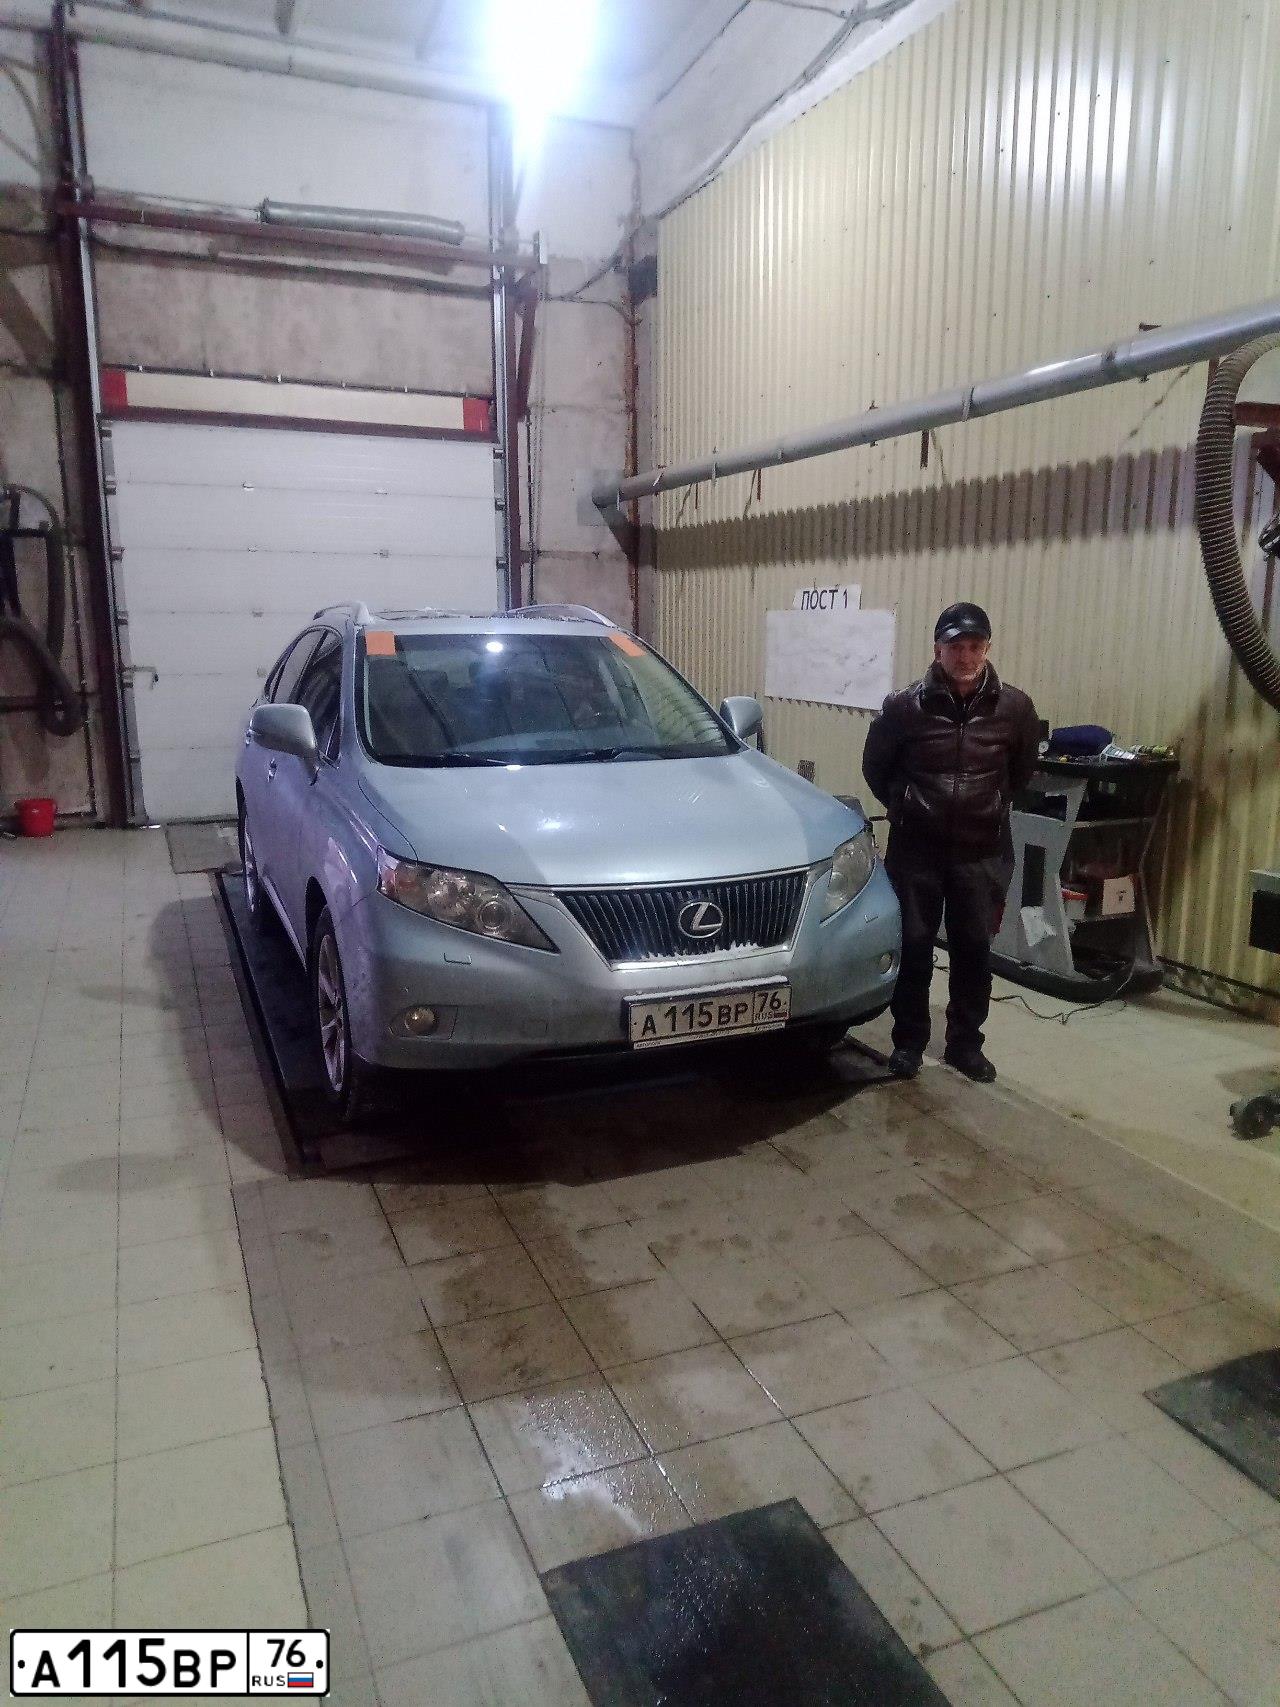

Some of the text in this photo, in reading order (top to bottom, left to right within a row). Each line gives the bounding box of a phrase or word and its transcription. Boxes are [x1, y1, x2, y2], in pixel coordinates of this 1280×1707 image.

[801, 589, 848, 610] ПОСТ 1
[642, 1002, 748, 1036] А115ВР
[757, 991, 781, 1012] 76
